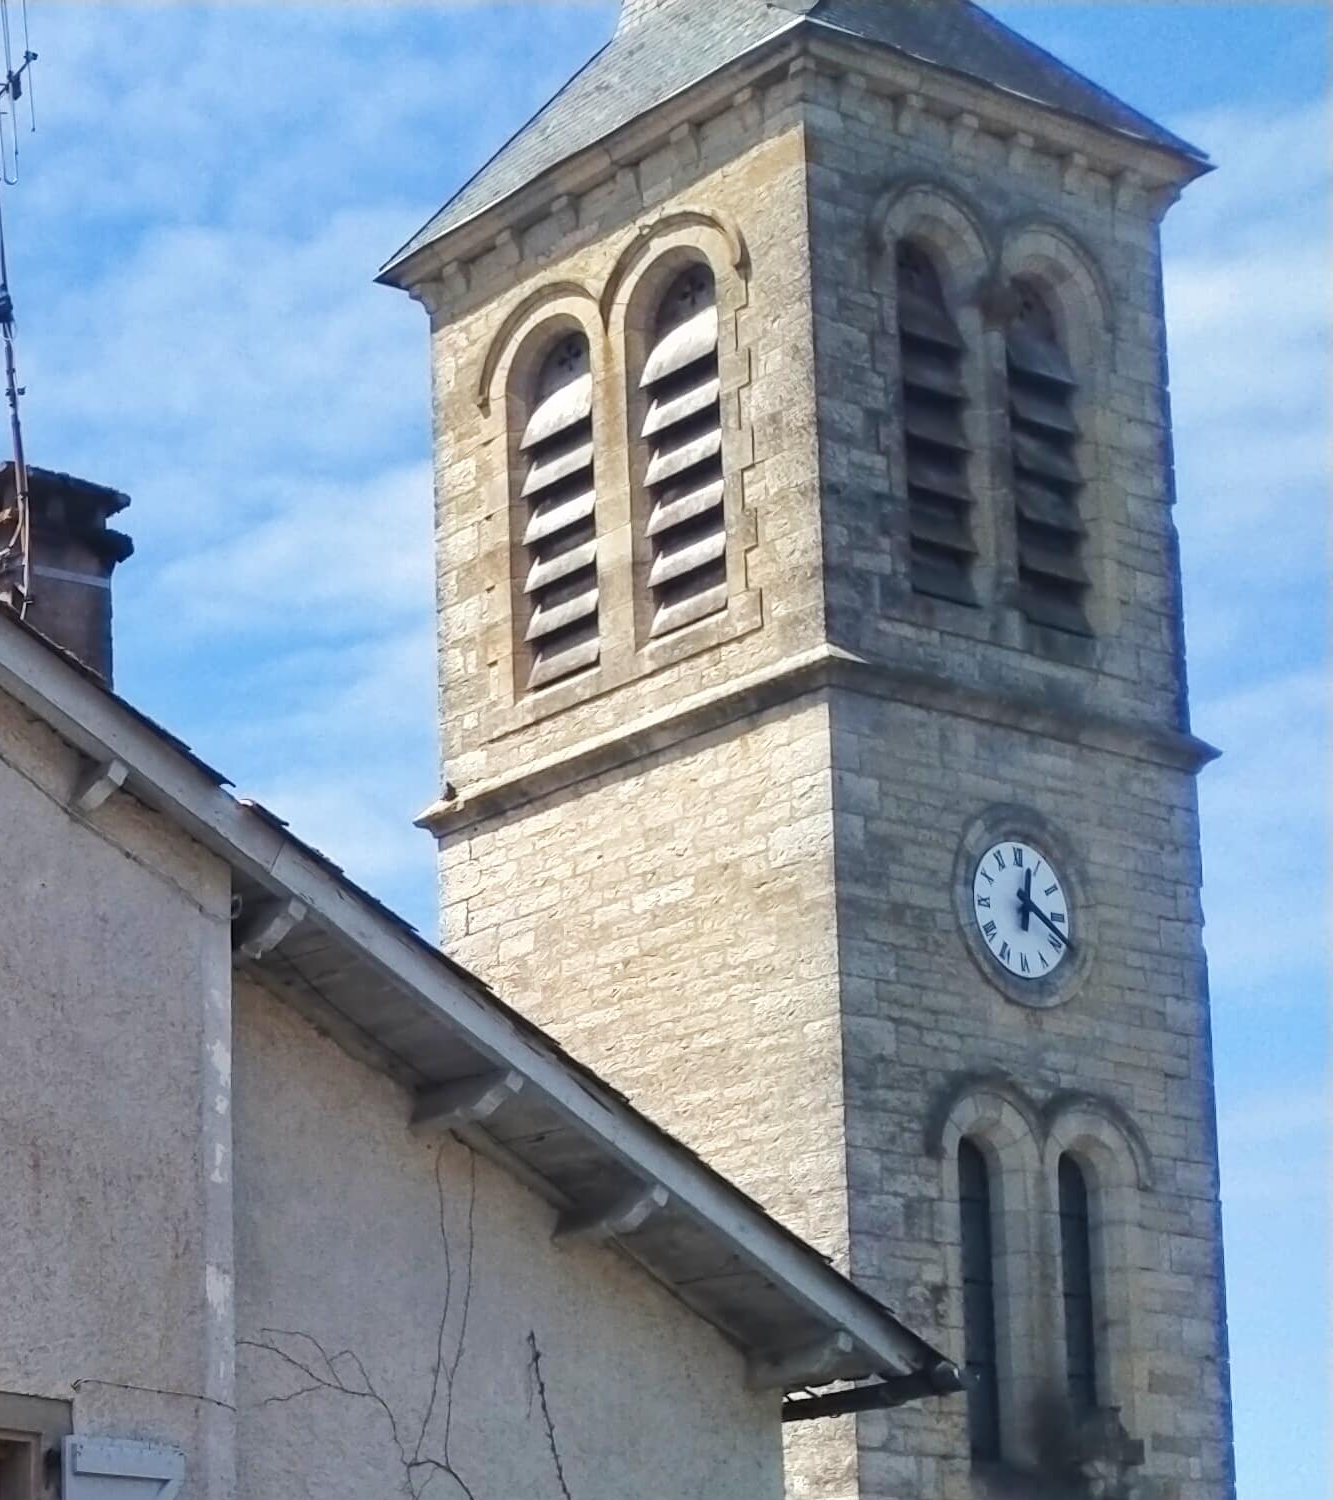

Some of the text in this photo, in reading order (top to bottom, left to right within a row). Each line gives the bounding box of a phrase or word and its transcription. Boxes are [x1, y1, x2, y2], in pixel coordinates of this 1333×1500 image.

[981, 867, 994, 886] X
[1045, 884, 1058, 896] II
[1051, 912, 1065, 923] III
